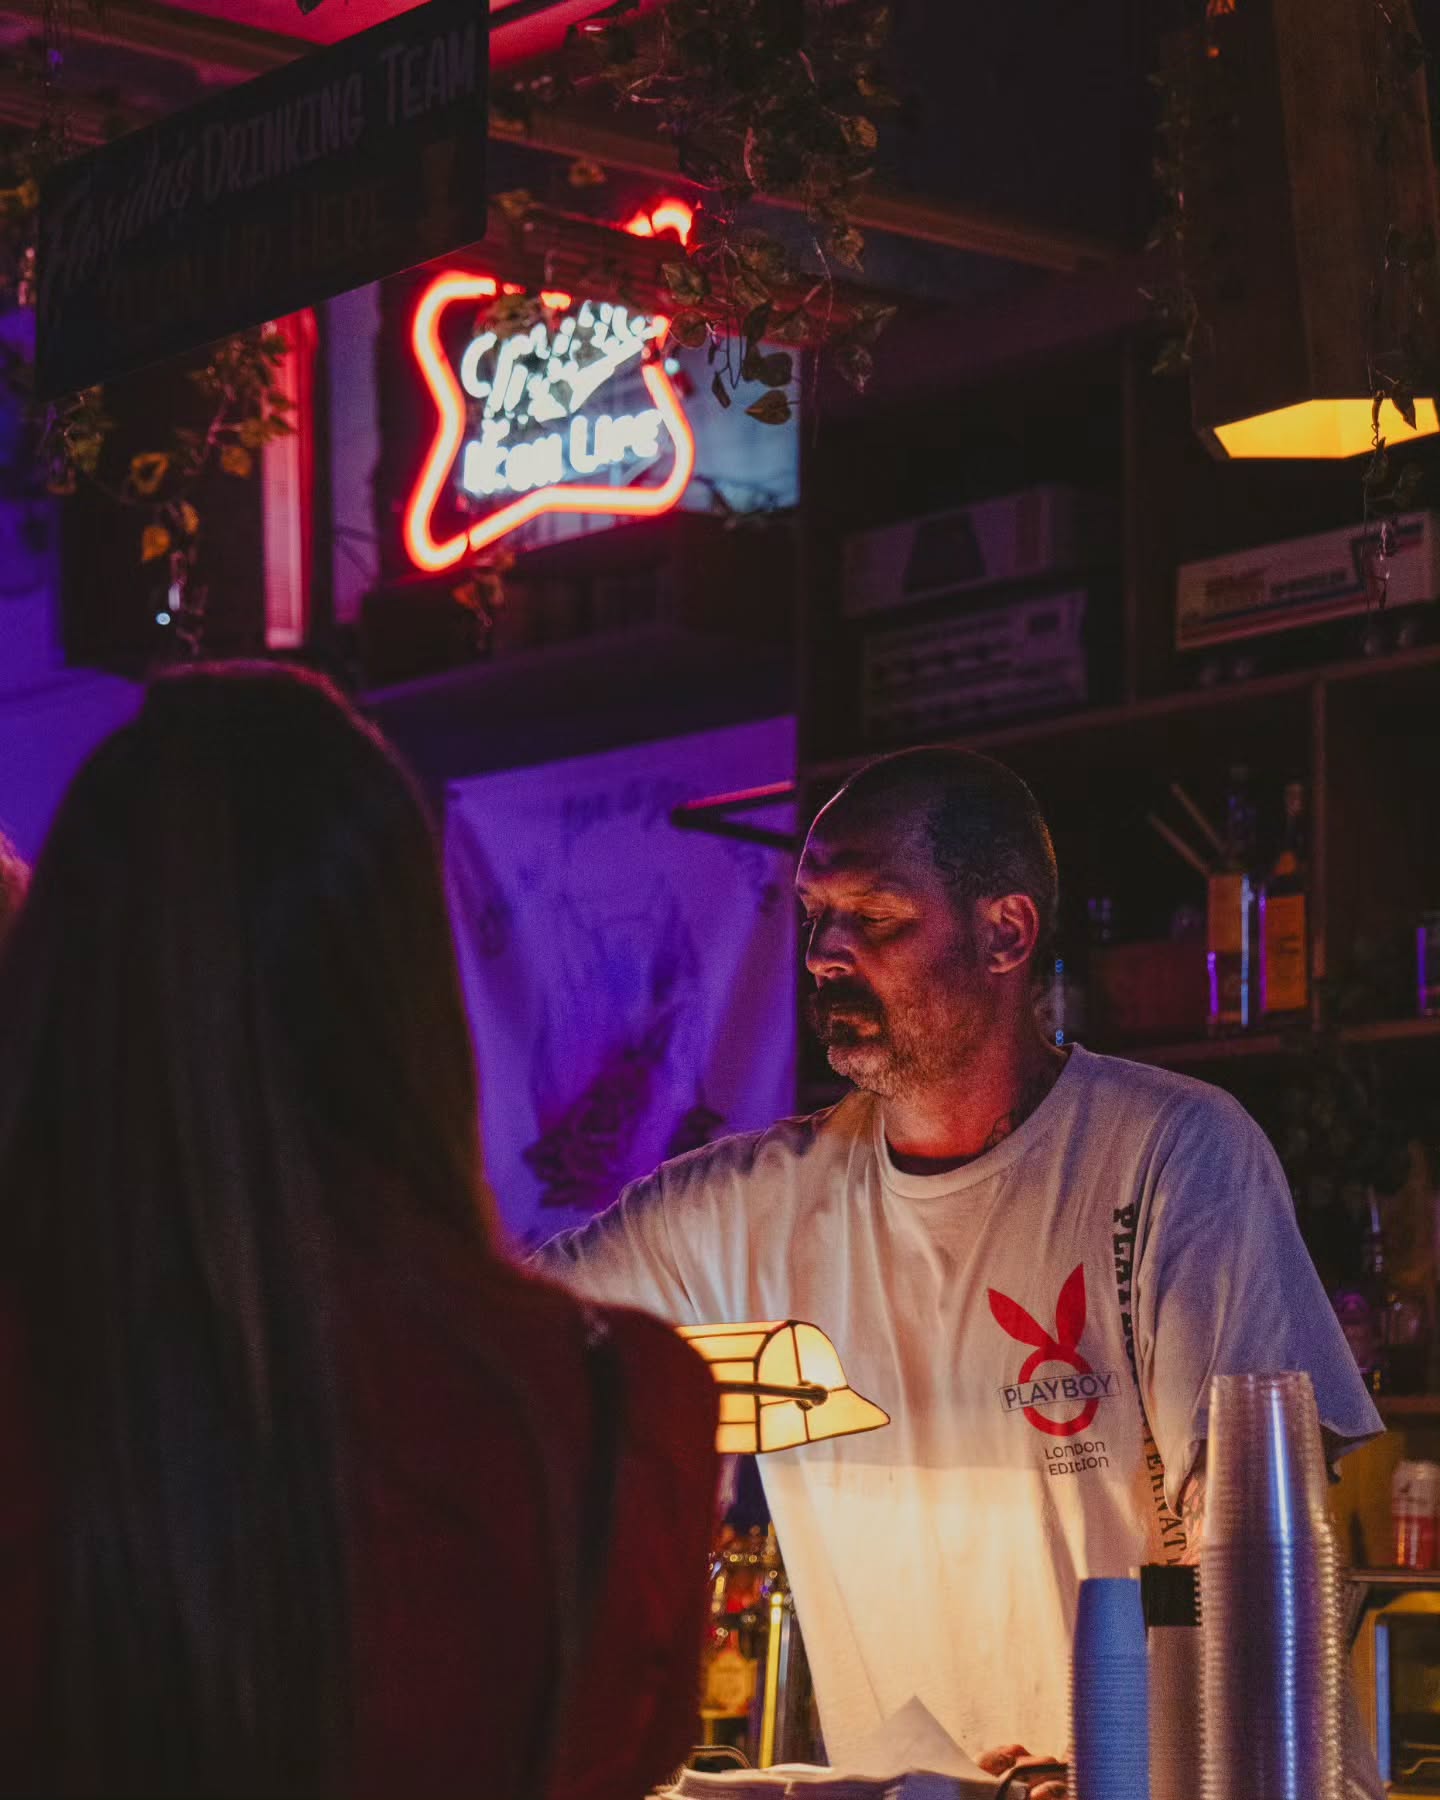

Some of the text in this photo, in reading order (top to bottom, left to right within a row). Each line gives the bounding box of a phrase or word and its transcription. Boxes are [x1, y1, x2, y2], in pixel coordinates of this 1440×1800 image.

[201, 73, 367, 202] DRINKING
[379, 24, 478, 126] TEAM
[1003, 1374, 1112, 1409] PLAYBOY
[1045, 1441, 1106, 1460] LONDON
